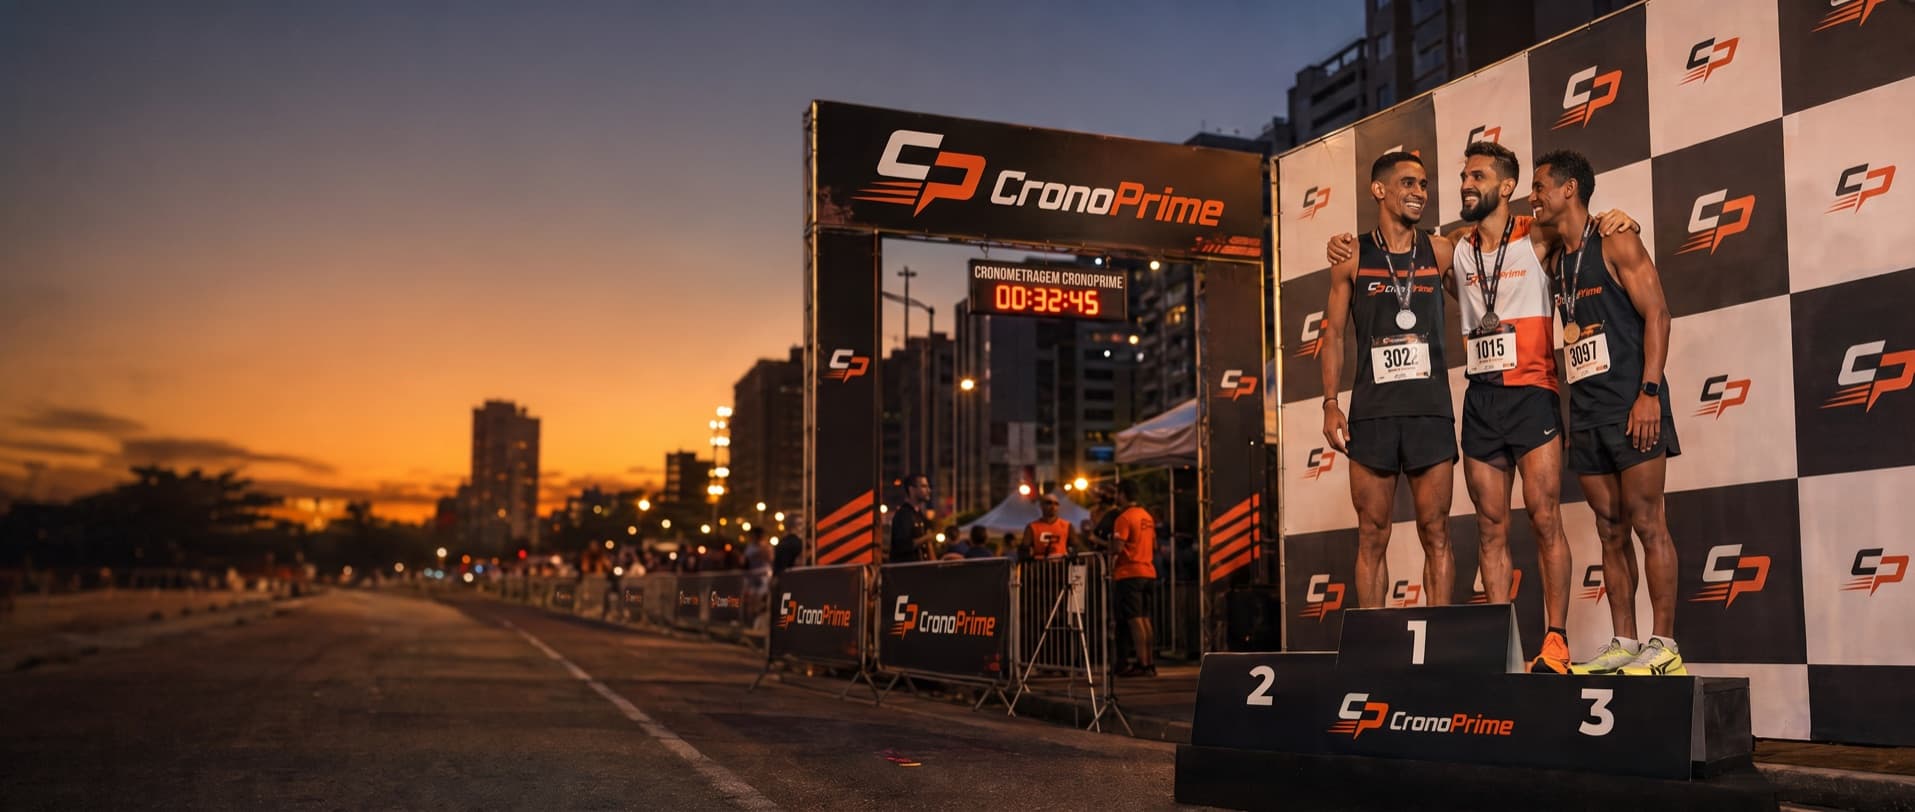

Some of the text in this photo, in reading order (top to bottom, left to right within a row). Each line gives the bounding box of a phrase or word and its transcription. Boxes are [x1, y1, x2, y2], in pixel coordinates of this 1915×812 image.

[990, 169, 1225, 227] CronoPrime
[974, 265, 1124, 289] CRONOMETRAGEM CRONOPRIME
[995, 284, 1099, 315] 00:32:45
[1475, 338, 1505, 360] 1015
[1569, 340, 1597, 368] 3097
[797, 604, 851, 628] CronoPrime
[919, 610, 996, 637] CronoPrime
[1407, 620, 1427, 665] 1
[1246, 665, 1276, 706] 2
[1390, 710, 1515, 736] CronoPrime
[1578, 688, 1615, 737] 3
